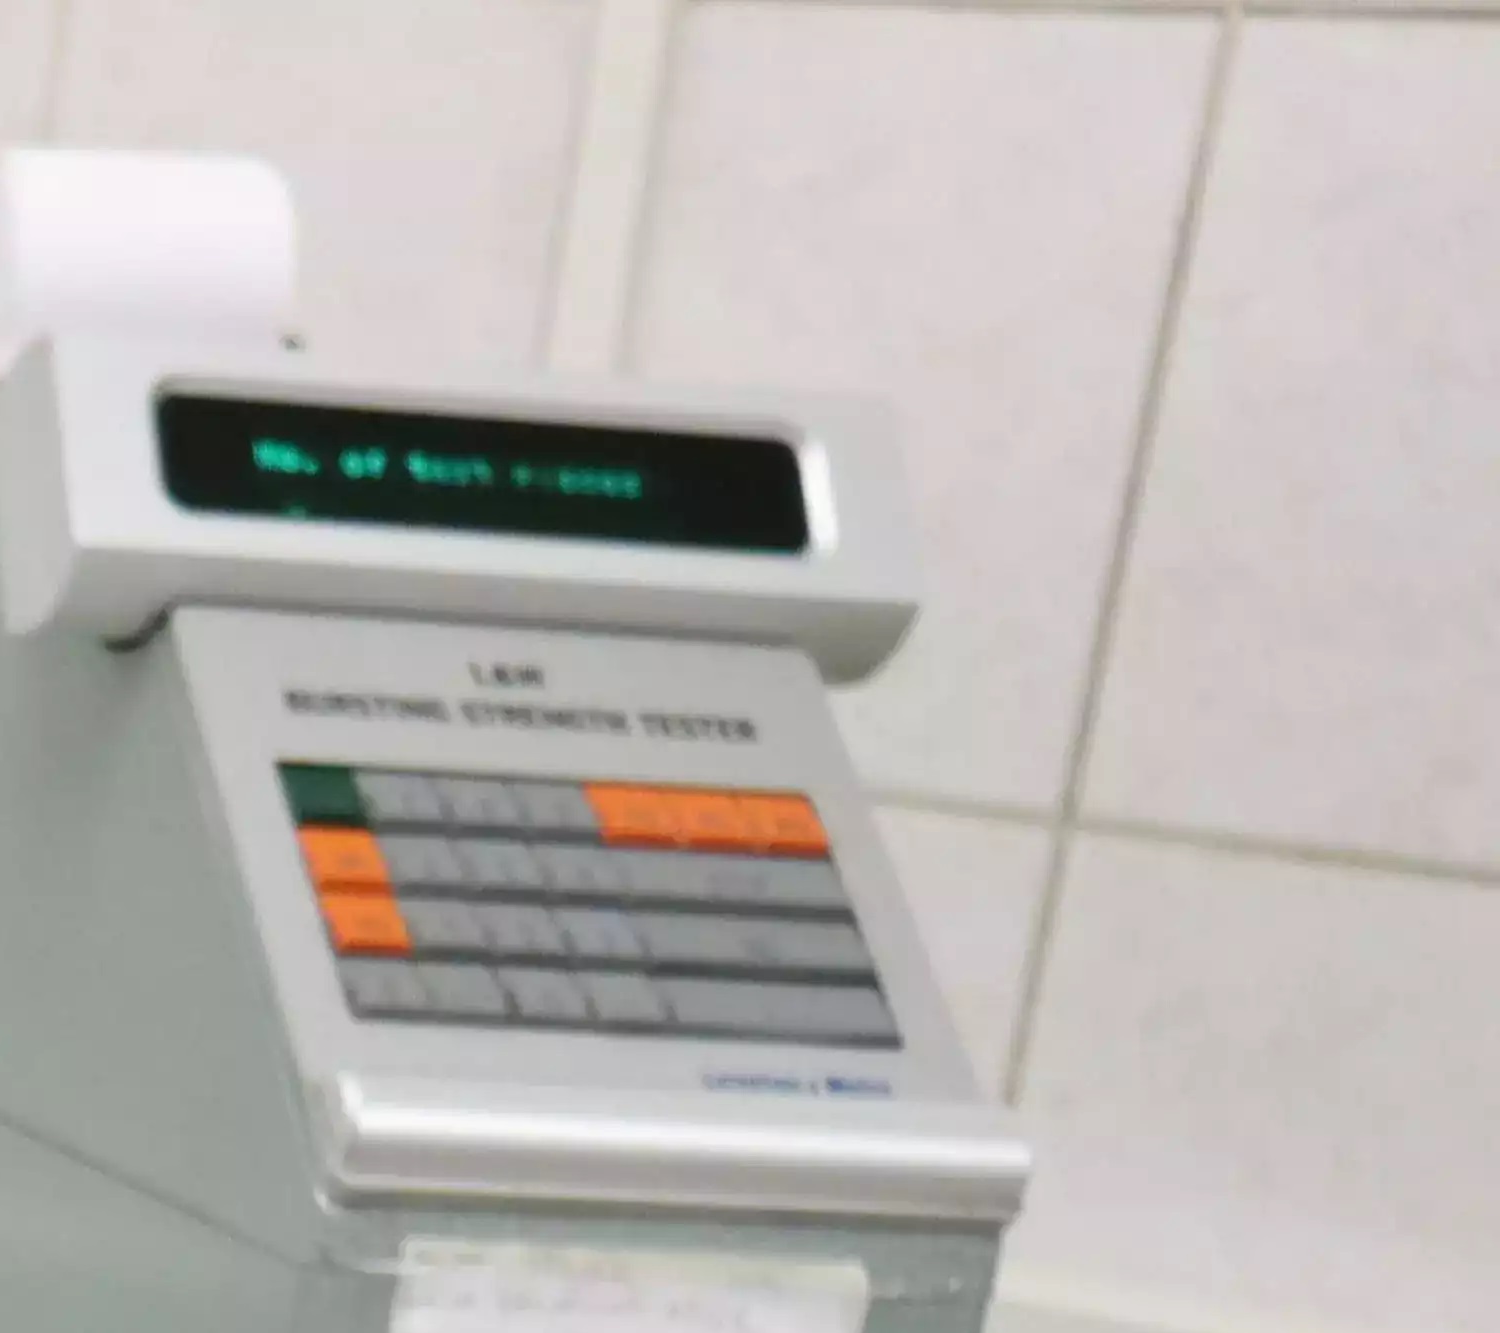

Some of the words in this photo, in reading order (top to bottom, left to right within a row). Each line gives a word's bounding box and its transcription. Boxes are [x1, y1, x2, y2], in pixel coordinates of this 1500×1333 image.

[285, 690, 449, 721] BURSTING
[459, 701, 631, 735] STRENGTH
[637, 712, 758, 742] TESTER
